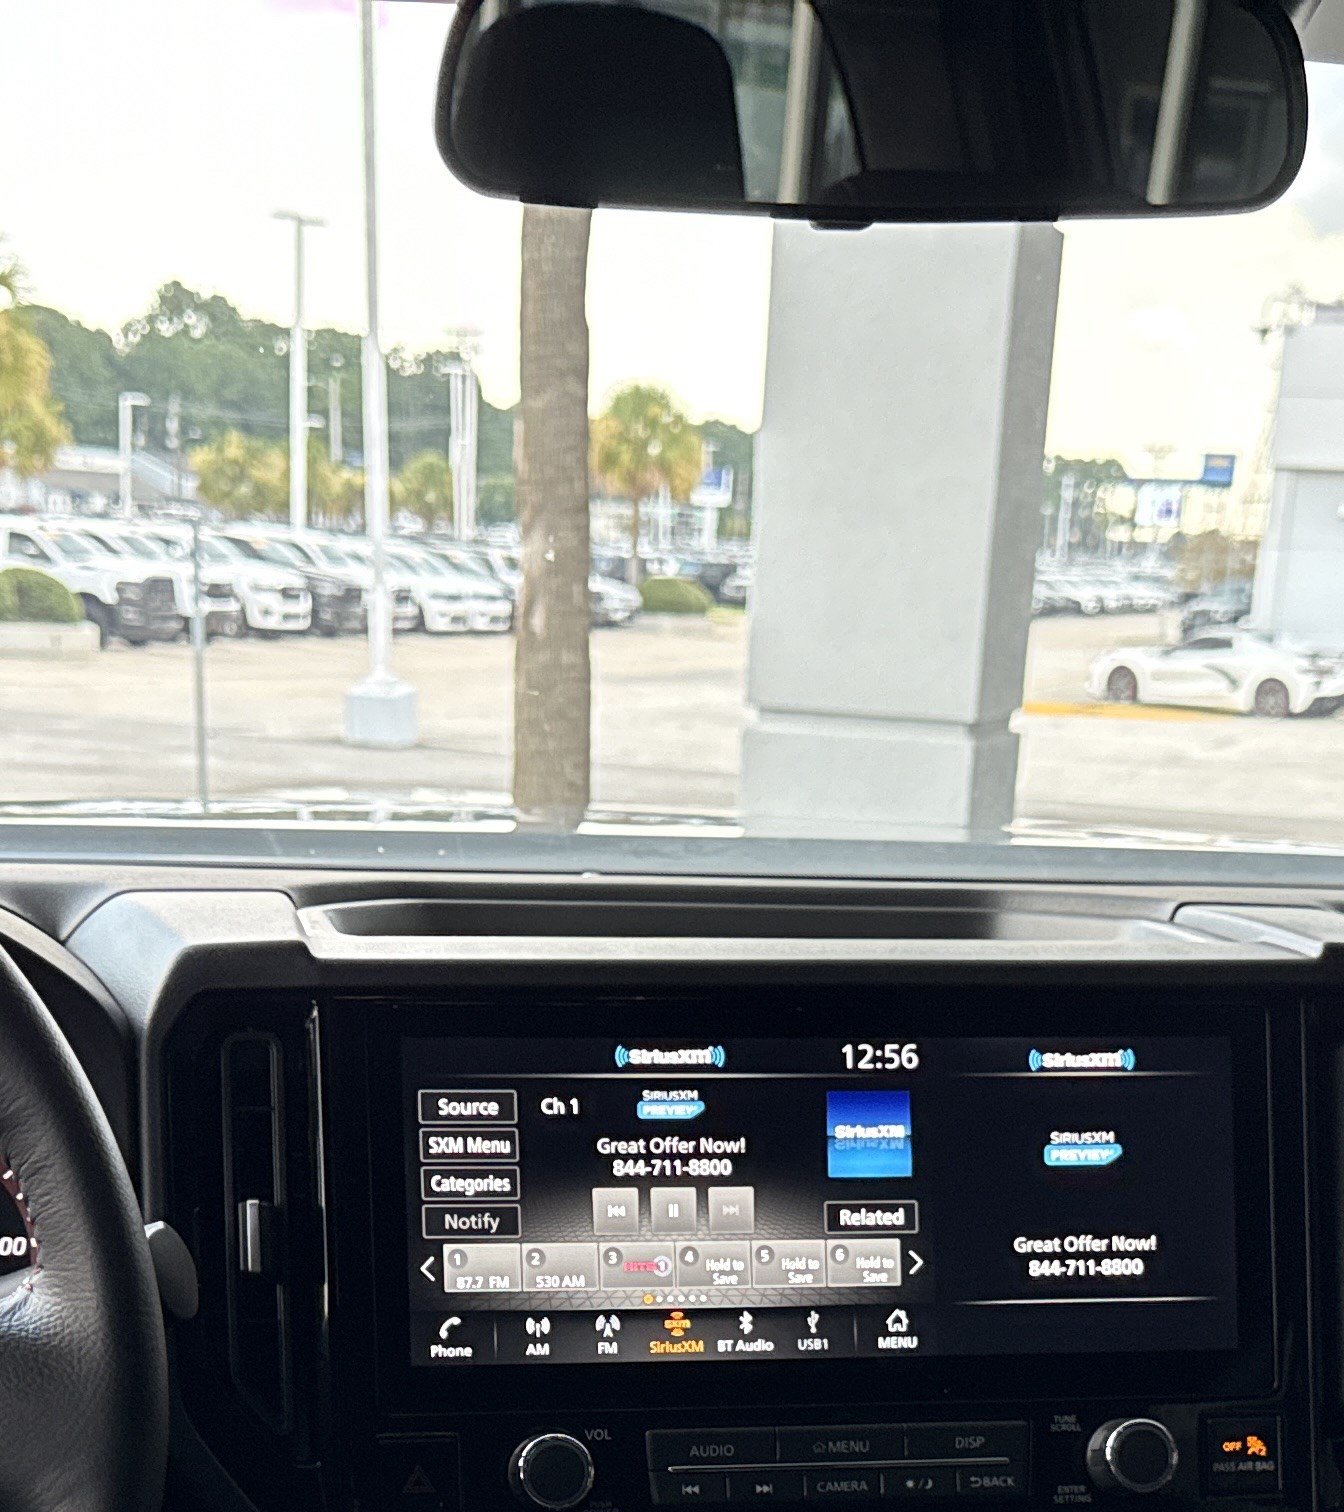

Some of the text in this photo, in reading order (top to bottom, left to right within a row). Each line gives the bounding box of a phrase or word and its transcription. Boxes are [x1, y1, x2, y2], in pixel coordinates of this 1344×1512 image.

[841, 1043, 920, 1070] 12:56
[642, 1089, 698, 1102] SIRIUSXM
[437, 1098, 499, 1117] Source
[540, 1097, 580, 1116] Ch 1
[1050, 1131, 1114, 1144] SIRIUSXM
[428, 1136, 511, 1155] SXM Menu
[597, 1136, 746, 1155] Great Offer Now!
[612, 1158, 733, 1177] 844-711-8800
[430, 1175, 511, 1194] Categories
[444, 1212, 500, 1233] Notify
[839, 1207, 905, 1227] Related
[1013, 1234, 1157, 1255] Great Offer Now!
[705, 1258, 745, 1272] Hold to
[781, 1257, 821, 1271] Hold to
[855, 1256, 895, 1270] Hold to
[1028, 1258, 1144, 1278] 844-711-8800
[456, 1276, 510, 1289] 87.7 FM
[535, 1275, 586, 1288] 530 AM
[712, 1272, 739, 1285] Save
[788, 1271, 815, 1284] Save
[862, 1270, 889, 1283] Save
[525, 1343, 550, 1356] AM
[597, 1342, 618, 1355] FM
[649, 1339, 705, 1354] SiriusXM
[717, 1339, 775, 1353] BT Audio
[797, 1338, 829, 1350] USB1
[877, 1336, 918, 1349] MENU
[430, 1344, 473, 1359] Phone
[583, 1428, 613, 1441] VOL
[828, 1440, 871, 1455] MENU
[955, 1436, 985, 1449] DISP
[1221, 1440, 1243, 1452] OFF
[689, 1443, 735, 1457] AUDIO
[817, 1479, 869, 1493] CAMERA
[982, 1474, 1015, 1487] BACK
